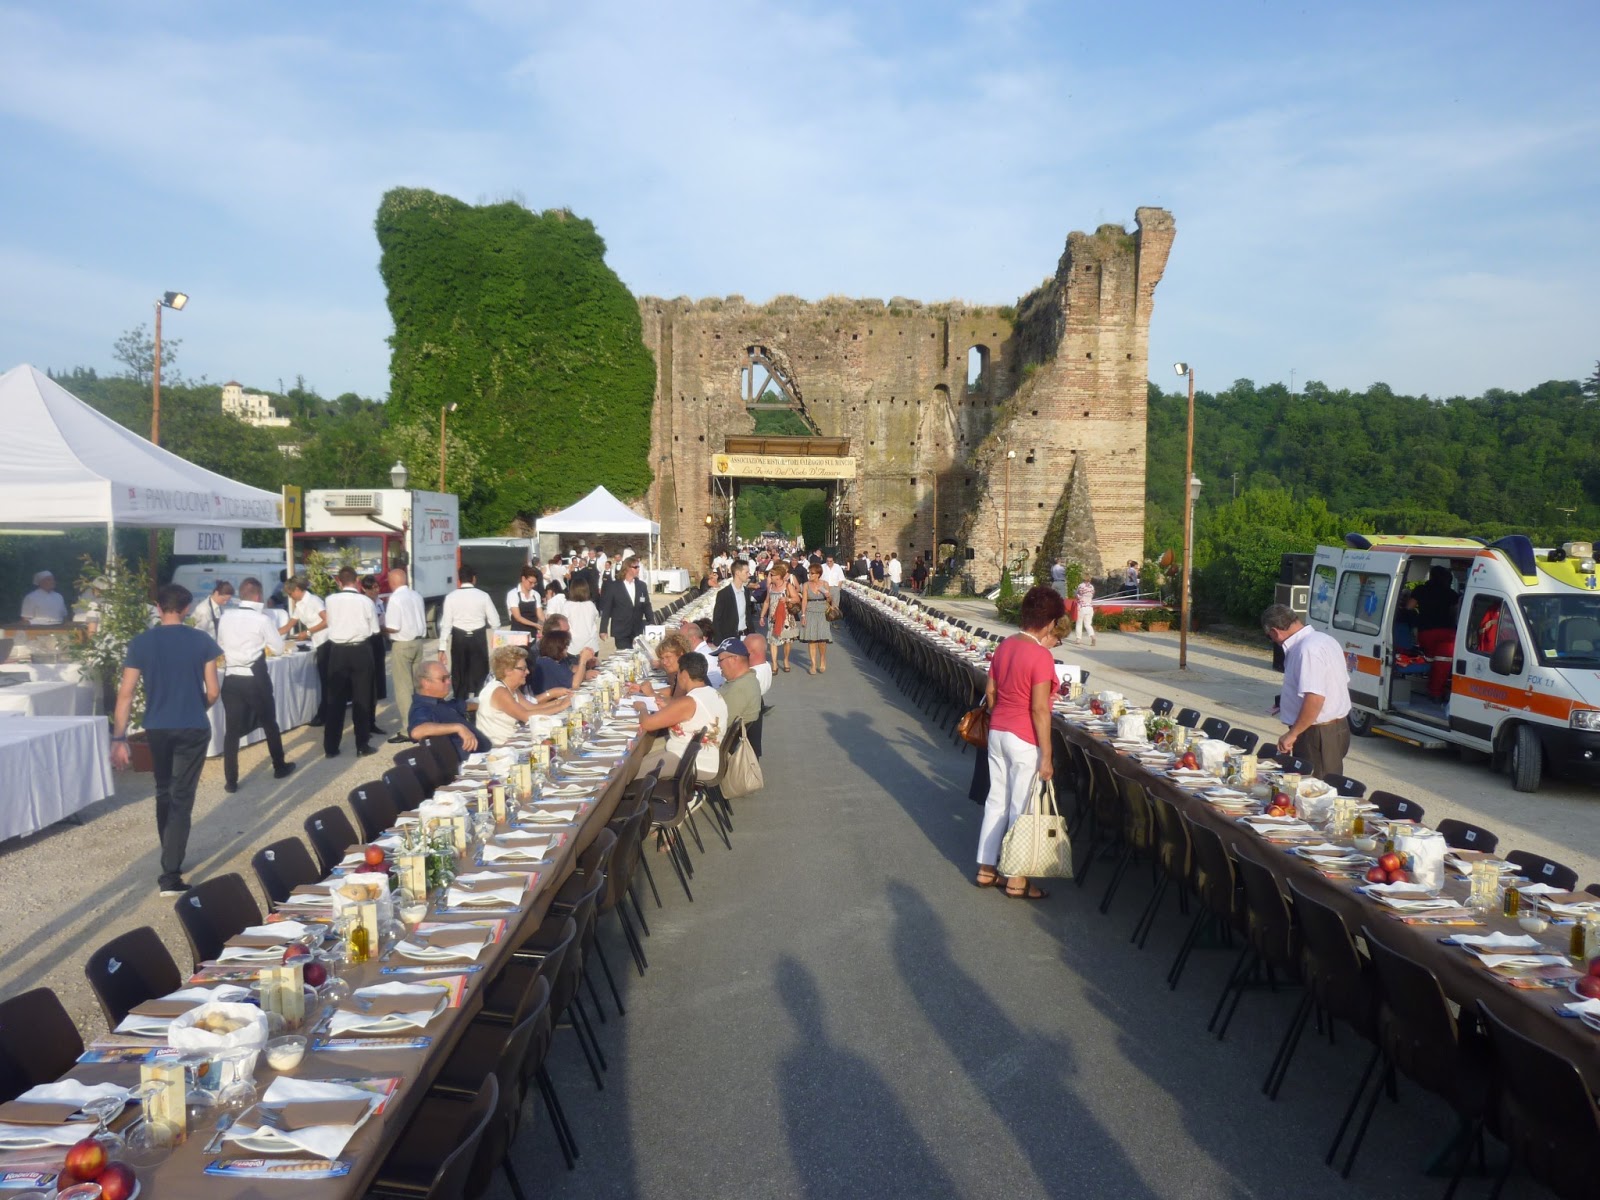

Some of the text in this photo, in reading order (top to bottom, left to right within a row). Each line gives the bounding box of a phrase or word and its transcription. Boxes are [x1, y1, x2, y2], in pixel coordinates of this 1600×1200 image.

[731, 456, 767, 465] ASSOCIAZIONE
[742, 466, 752, 474] La
[754, 466, 773, 475] Festa
[808, 466, 841, 476] D'Amore
[174, 490, 210, 512] CUCINA
[242, 498, 272, 518] BAGNO
[198, 532, 225, 551] EDEN
[1526, 674, 1542, 686] FOX
[156, 1048, 179, 1056] Robert
[4, 1172, 40, 1180] Roberto
